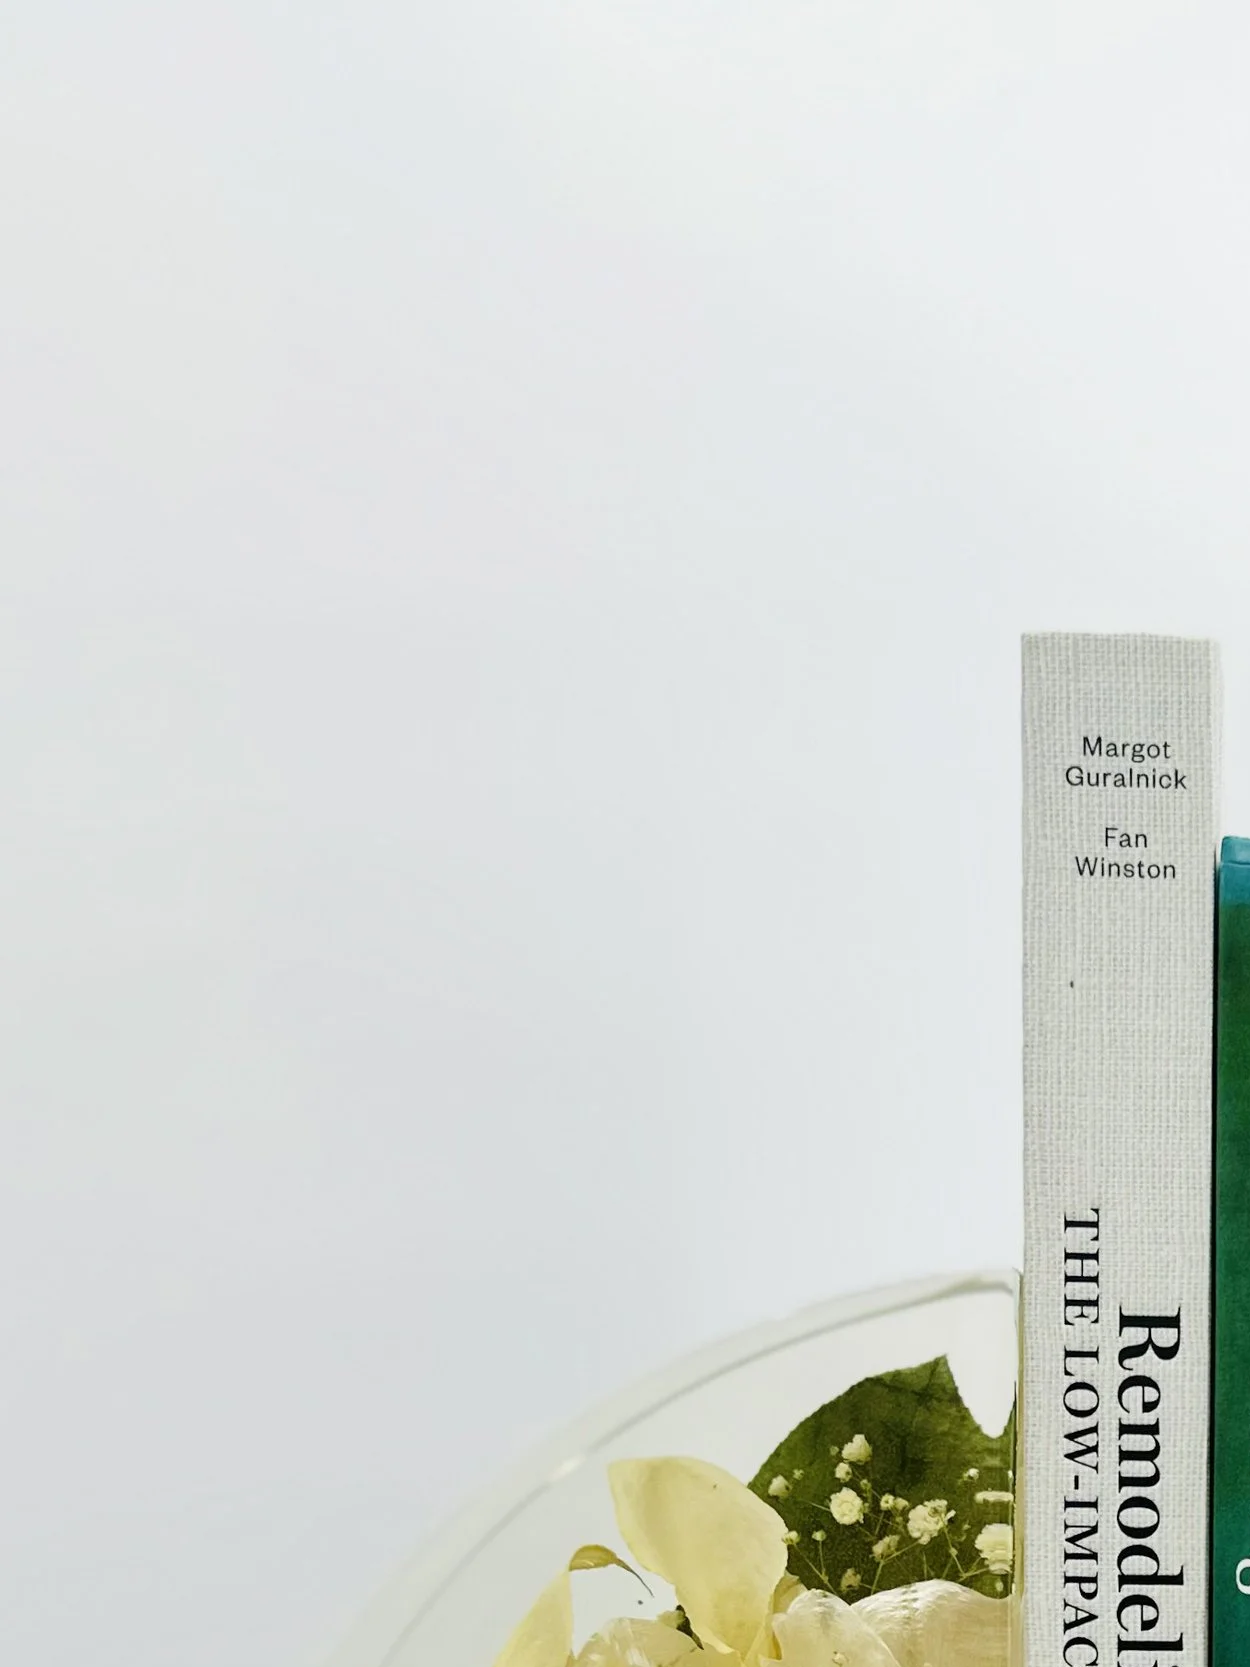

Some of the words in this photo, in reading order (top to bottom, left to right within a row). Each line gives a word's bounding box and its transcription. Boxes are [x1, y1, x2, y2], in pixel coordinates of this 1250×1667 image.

[1082, 736, 1171, 764] Margot
[1065, 766, 1188, 790] Guralnick
[1104, 827, 1148, 849] Fan
[1075, 856, 1176, 880] Winston
[1063, 1208, 1100, 1326] THE
